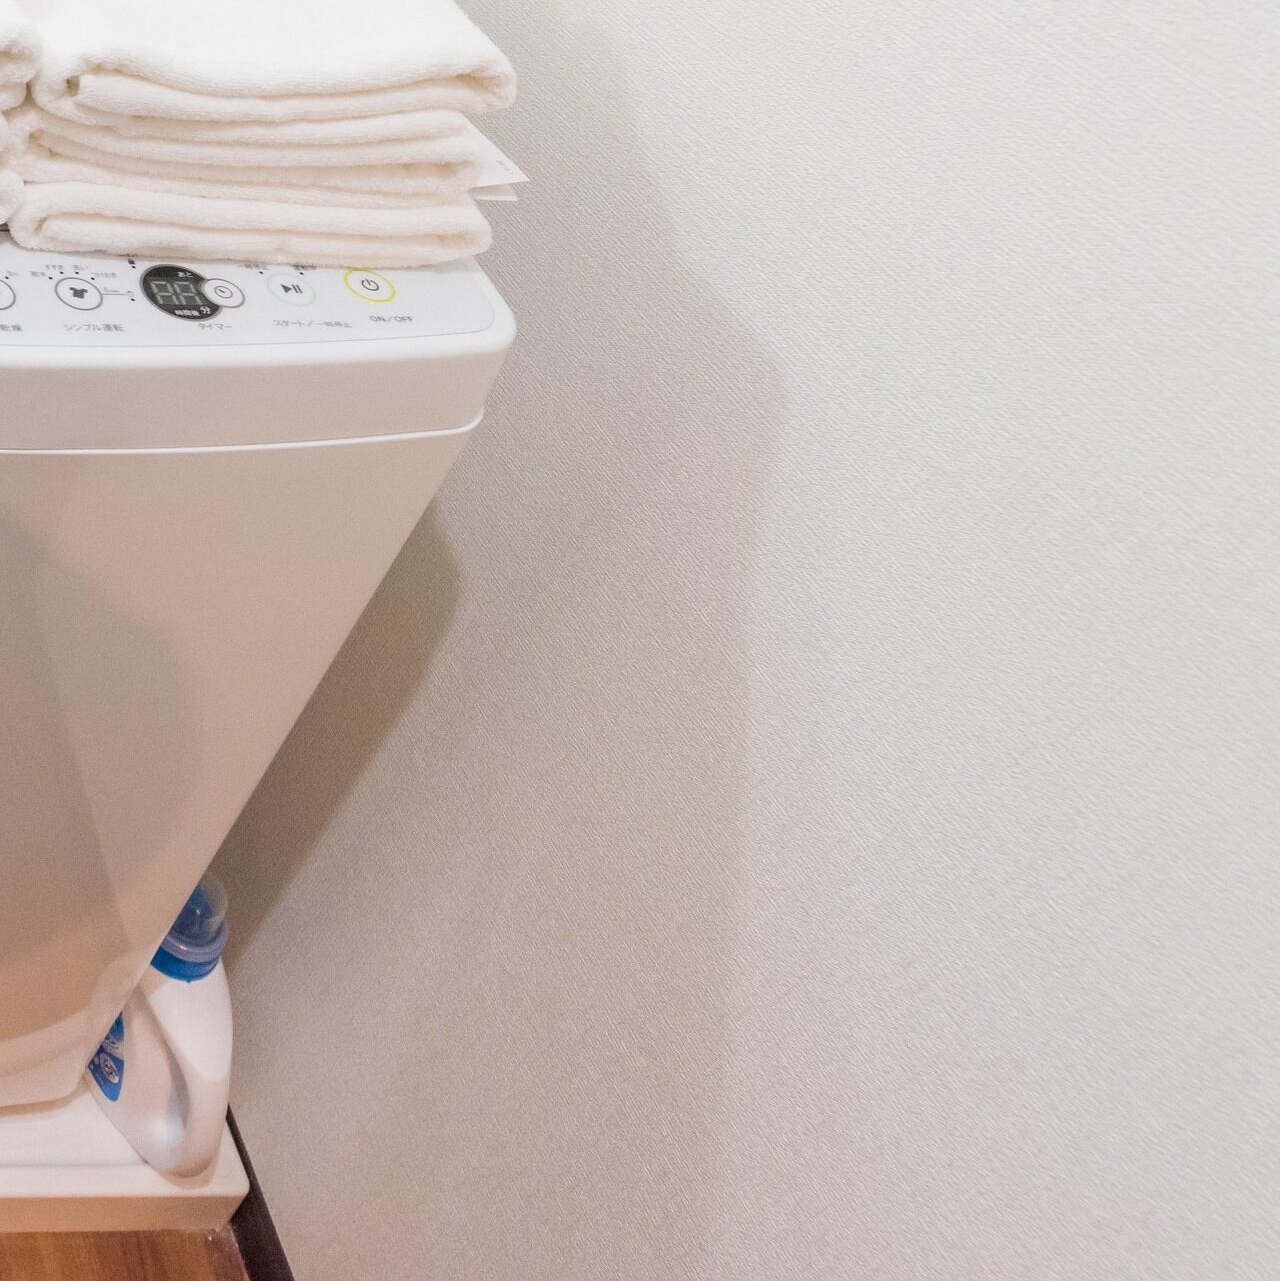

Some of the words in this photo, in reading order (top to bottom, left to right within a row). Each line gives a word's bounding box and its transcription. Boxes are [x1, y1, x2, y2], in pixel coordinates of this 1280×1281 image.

[369, 315, 413, 323] ON/OFF
[64, 323, 124, 332] シンプル運転
[198, 322, 233, 331] タイマー
